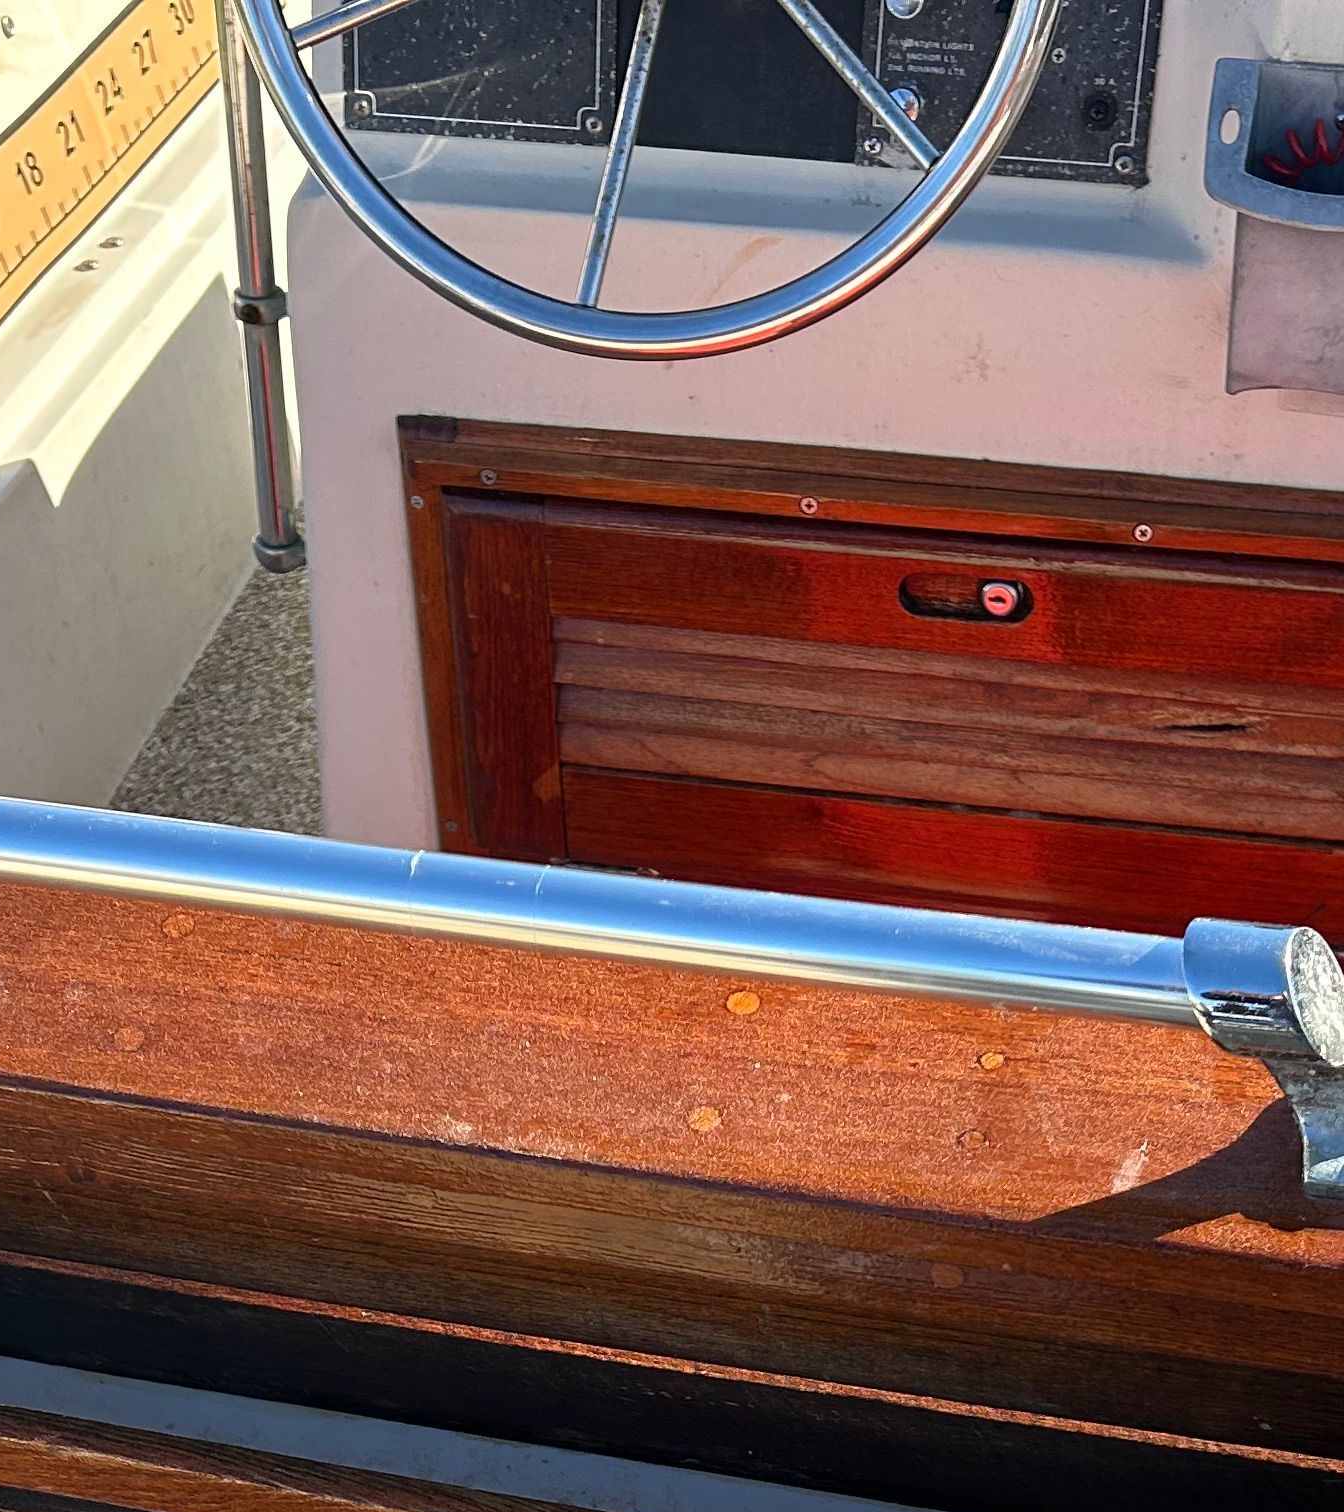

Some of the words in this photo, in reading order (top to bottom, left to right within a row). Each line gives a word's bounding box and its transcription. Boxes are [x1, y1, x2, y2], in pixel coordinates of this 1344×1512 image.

[16, 151, 44, 195] 18
[56, 109, 85, 158] 21
[94, 67, 124, 116] 24
[131, 28, 157, 76] 27
[167, 0, 194, 35] 30
